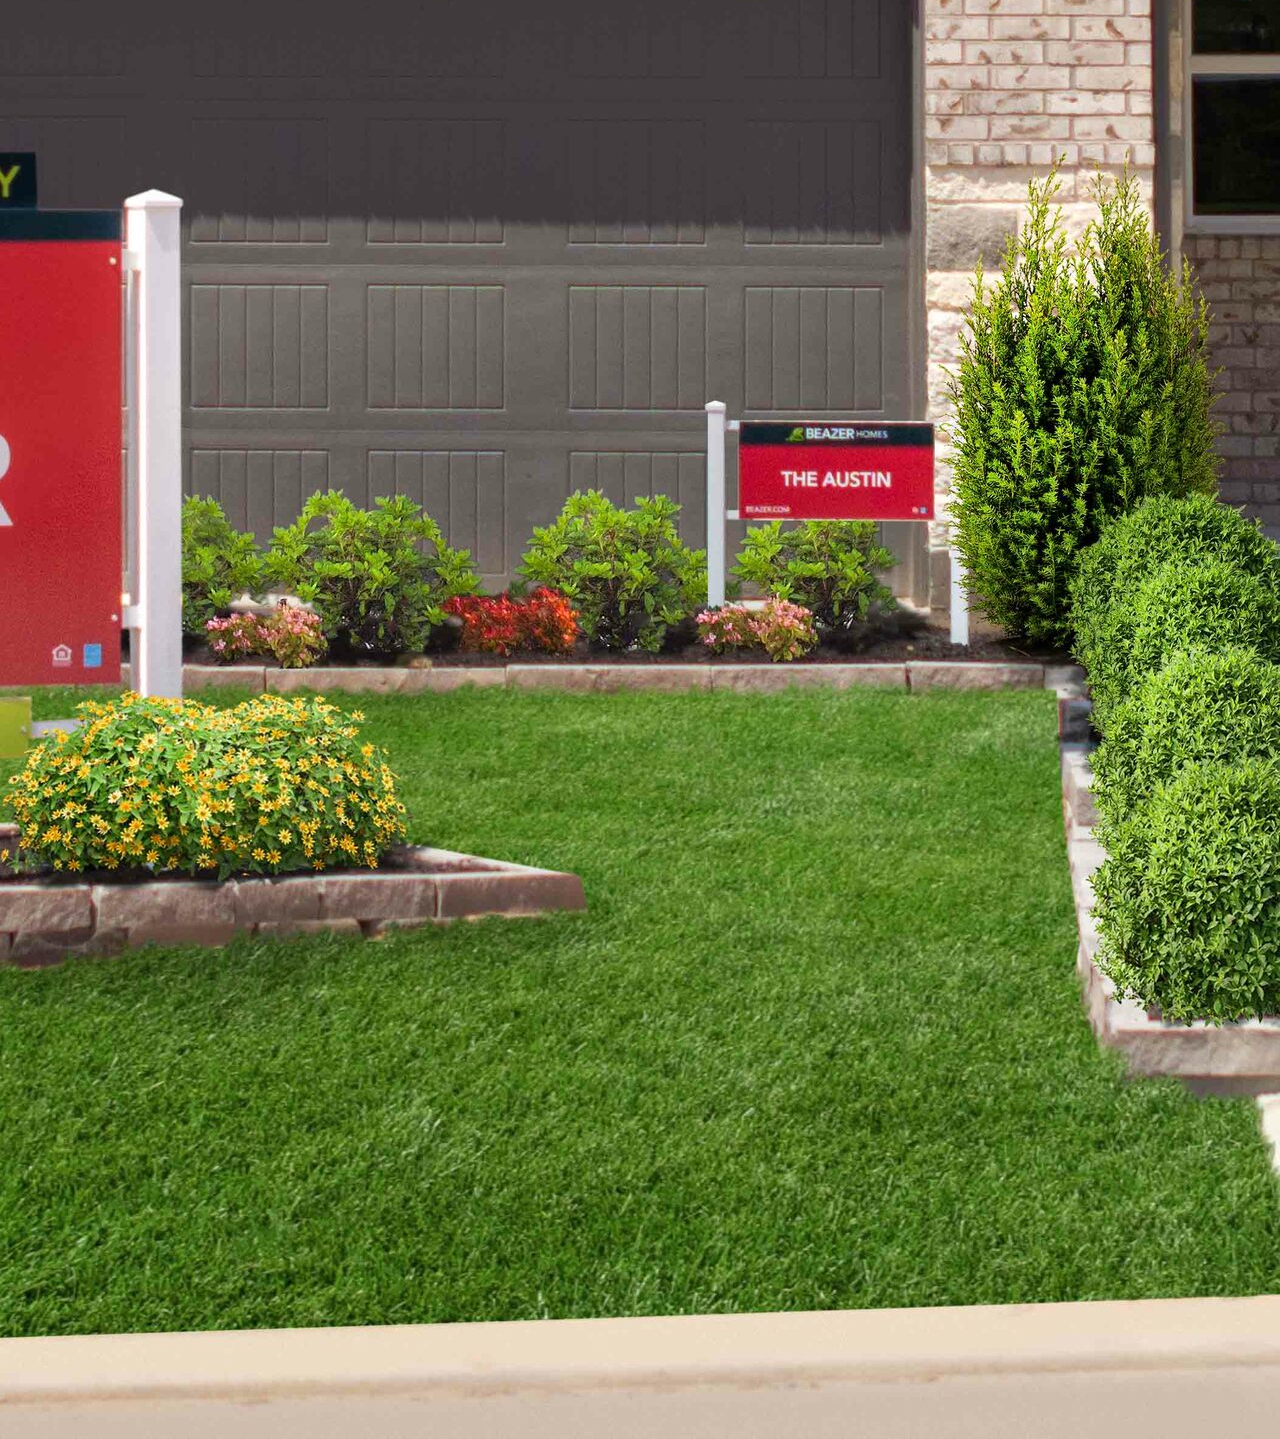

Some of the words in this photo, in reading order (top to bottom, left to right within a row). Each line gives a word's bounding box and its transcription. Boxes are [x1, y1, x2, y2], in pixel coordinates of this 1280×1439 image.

[805, 427, 855, 440] BEAZER
[856, 429, 888, 439] HOMES
[781, 471, 818, 488] THE
[822, 471, 891, 488] AUSTIN
